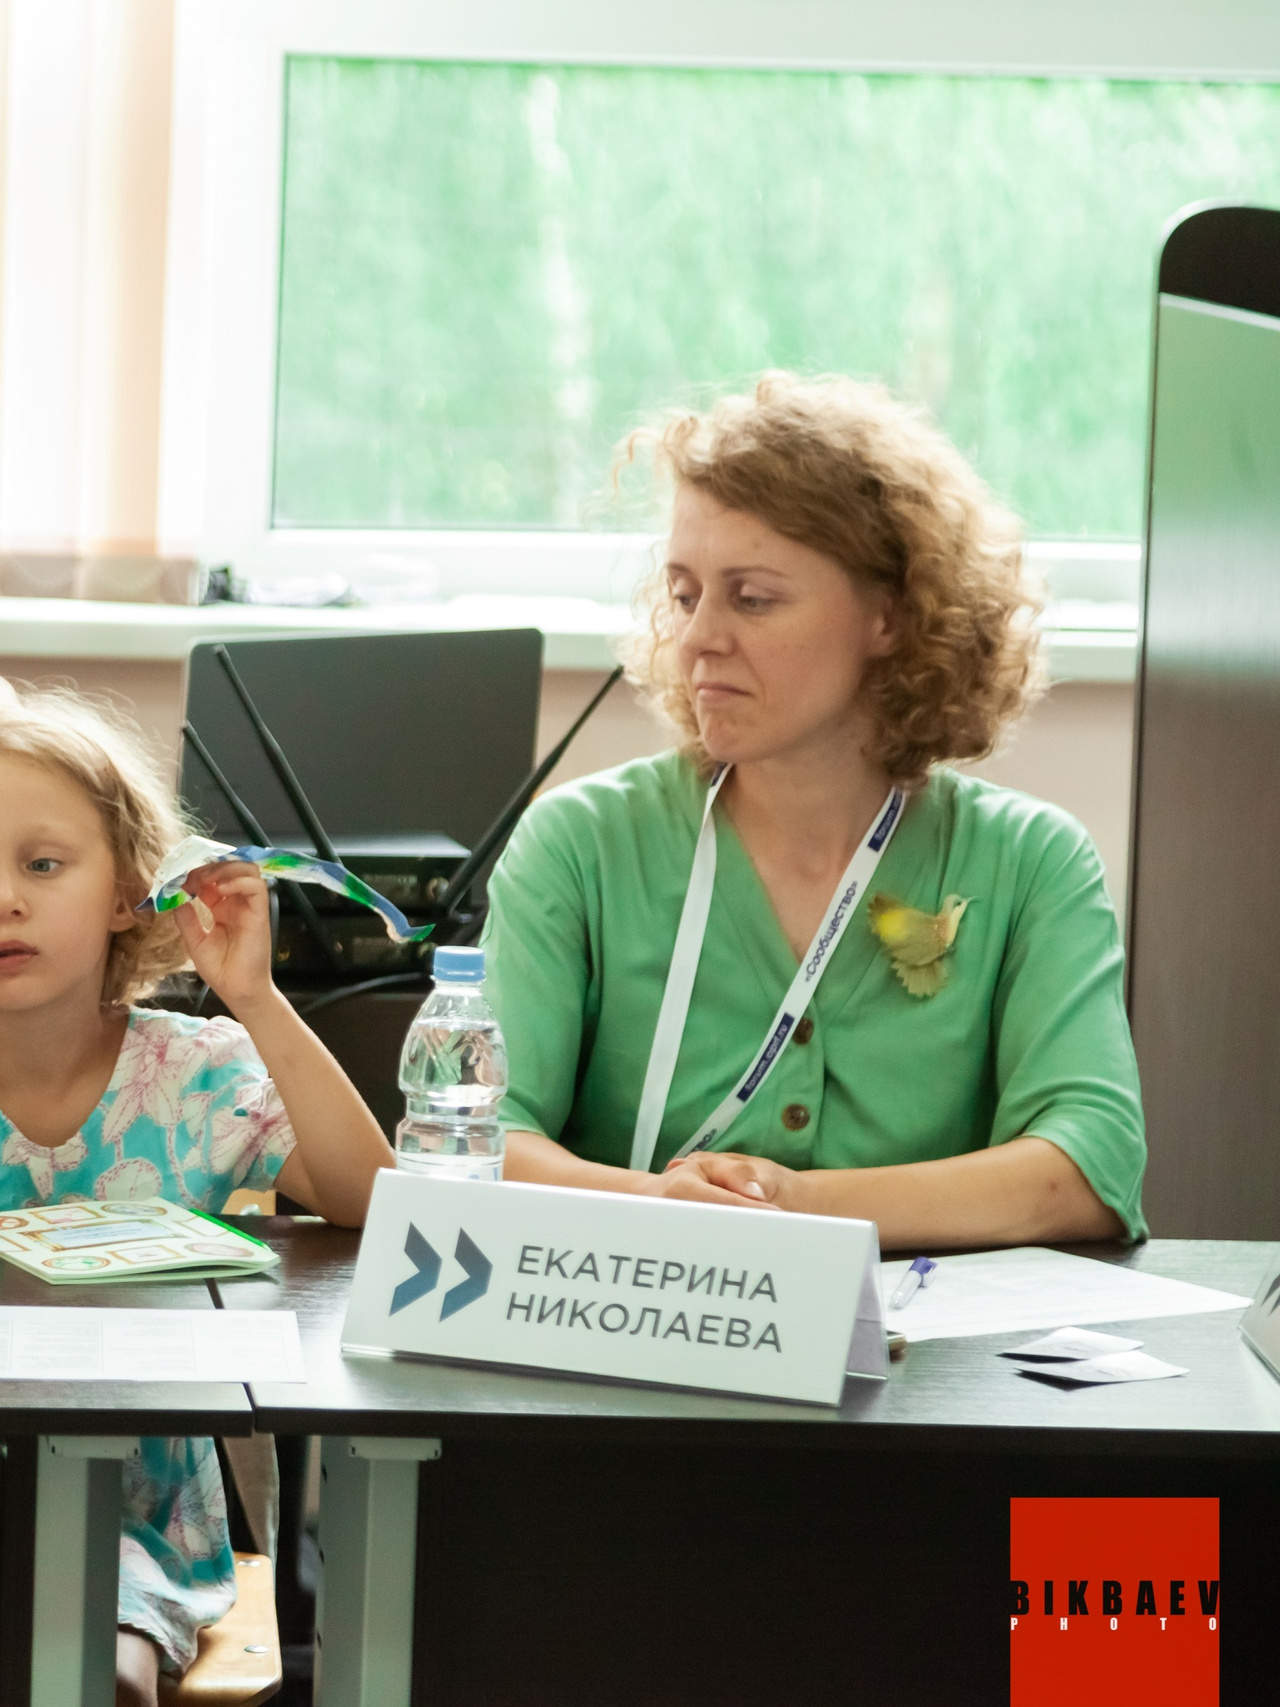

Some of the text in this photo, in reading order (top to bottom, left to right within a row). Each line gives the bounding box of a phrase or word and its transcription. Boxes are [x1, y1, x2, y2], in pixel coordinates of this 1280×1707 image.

[805, 881, 857, 982] «Сообщество»
[517, 1245, 778, 1303] ЕКАТЕРИНА
[506, 1292, 782, 1353] НИКОЛАЕВА
